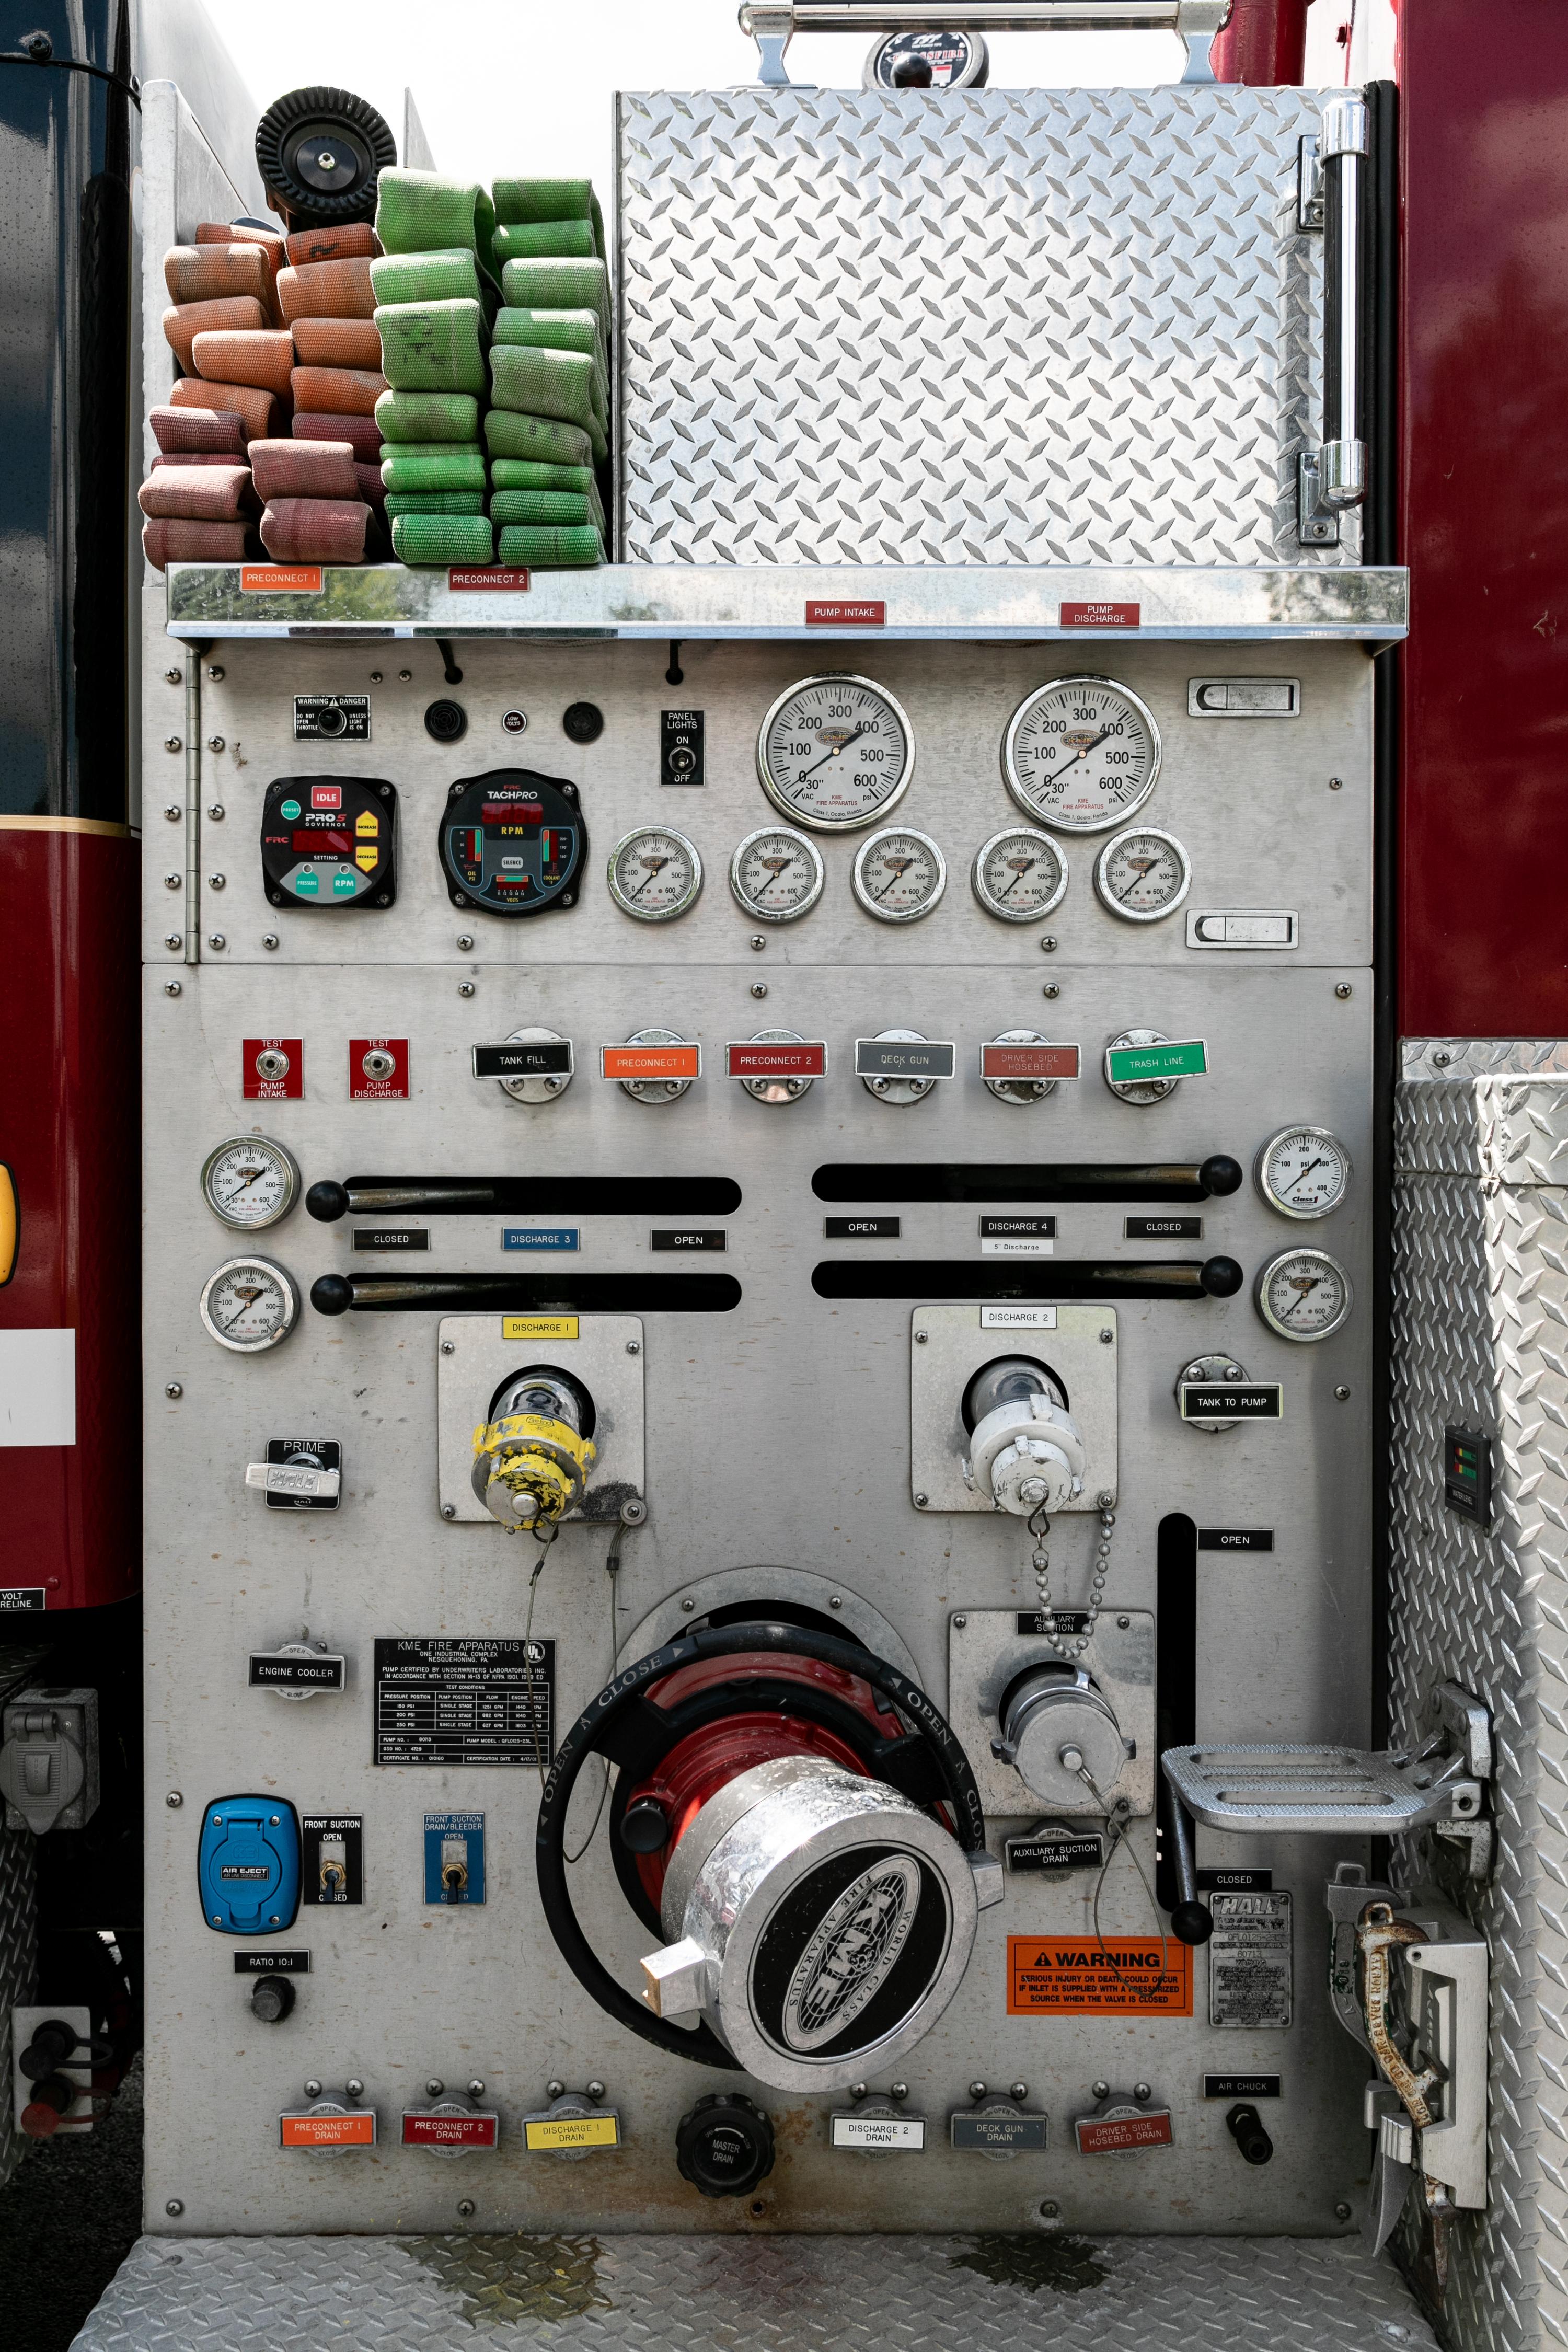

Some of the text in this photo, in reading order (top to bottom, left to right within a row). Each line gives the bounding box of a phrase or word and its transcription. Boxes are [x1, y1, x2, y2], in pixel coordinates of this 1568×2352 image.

[828, 705, 852, 717] 300
[1073, 708, 1097, 720] 300
[798, 717, 822, 729] 200
[1043, 720, 1066, 733] 200
[789, 743, 811, 755] 100
[1034, 747, 1056, 759] 100
[860, 750, 884, 761] 500
[1105, 752, 1129, 764] 500
[854, 774, 877, 786] 600
[1099, 777, 1122, 789] 600
[527, 1055, 547, 1064] FILL
[881, 1054, 906, 1064] DECK
[1130, 1057, 1184, 1068] TRASH LINE
[284, 1442, 325, 1452] PRIME
[398, 1642, 520, 1651] KME FIRE APPARATUS
[598, 1655, 663, 1708] CLOSE
[907, 1691, 952, 1746] OPEN
[545, 1739, 572, 1803] OPEN
[1014, 1844, 1097, 1857] AUXILIARY SUCTION
[1043, 1854, 1068, 1863] DRAIN
[789, 1918, 837, 2007] APPARATUS
[843, 1910, 912, 2020] WORLD CLASS
[1055, 1953, 1160, 1967] WARNING
[295, 2123, 353, 2131] PRECONNECT
[415, 2122, 474, 2130] PRECONNECT
[543, 2125, 591, 2135] DISCHARGE
[849, 2125, 897, 2134] DISCHARGE
[1096, 2123, 1152, 2137] DRIVER SIDE
[1089, 2130, 1162, 2146] HOSEBED DRAIN
[712, 2140, 740, 2153] MASTER
[713, 2152, 733, 2163] DRAIN
